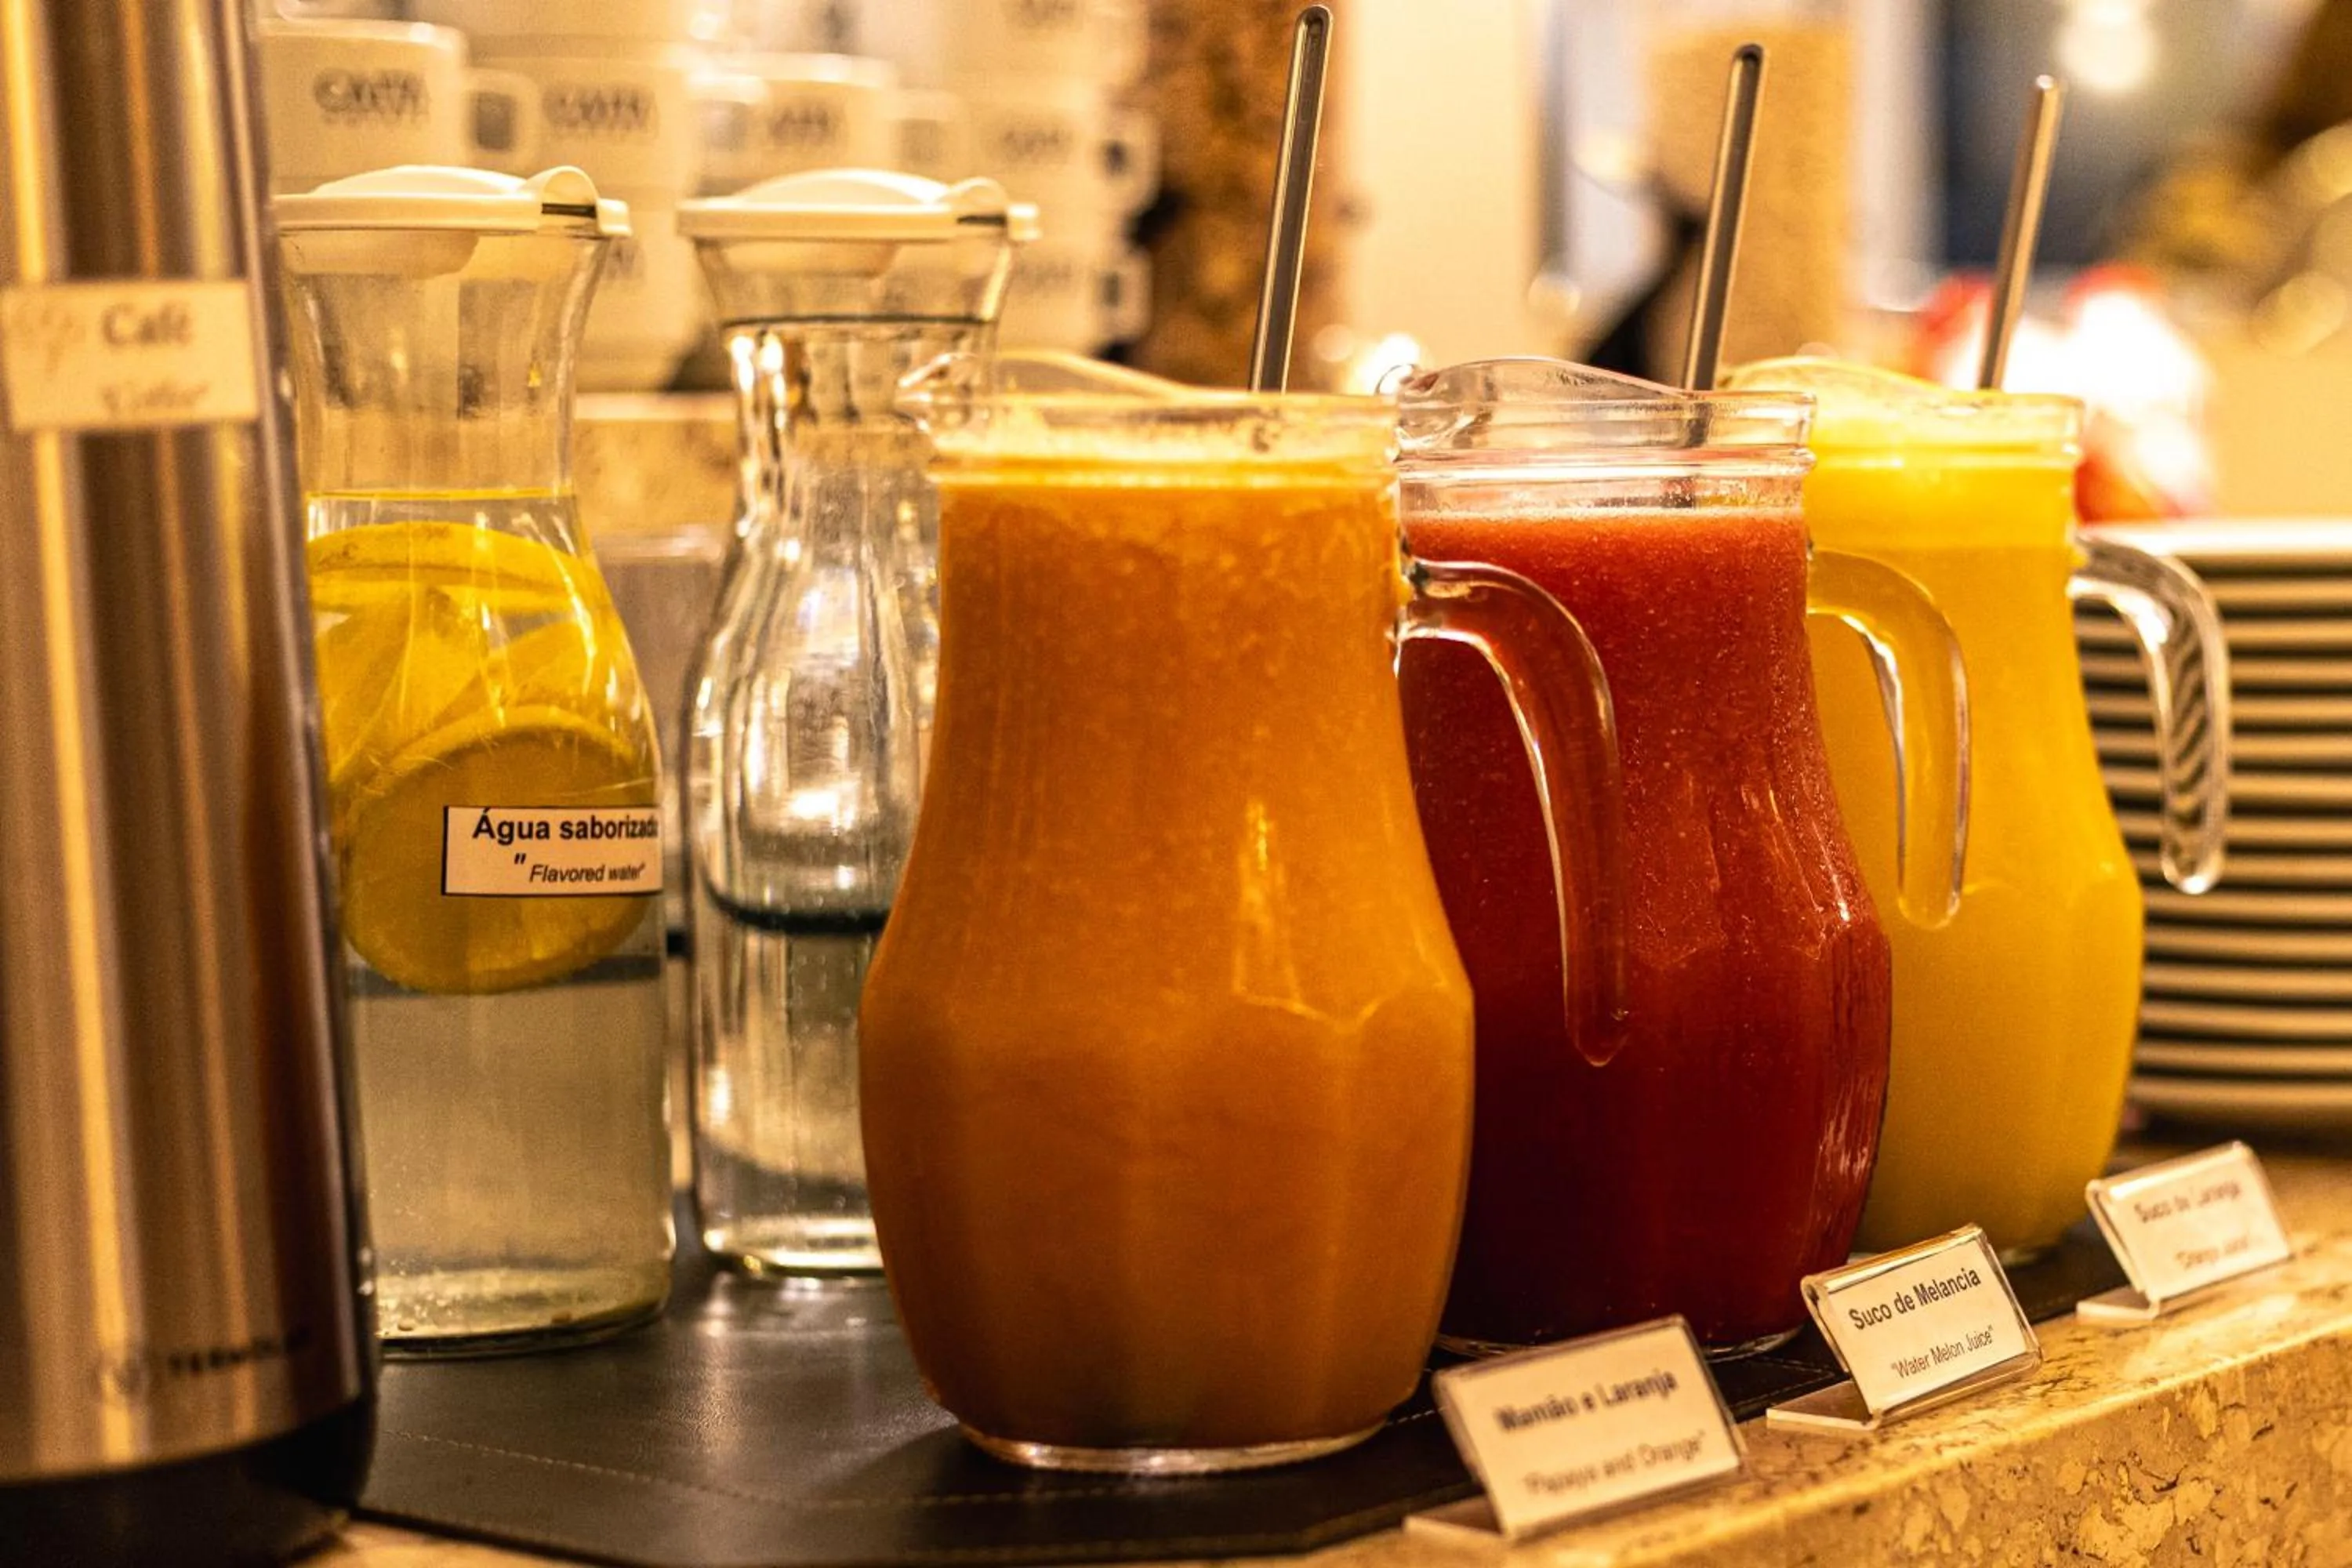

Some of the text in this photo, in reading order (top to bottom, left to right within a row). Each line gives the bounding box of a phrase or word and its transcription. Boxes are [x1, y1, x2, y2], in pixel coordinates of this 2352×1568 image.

[473, 808, 550, 845] Água
[1848, 1267, 1981, 1330] Suco de Melancia
[1891, 1324, 1994, 1379] "Water Melon Juice"
[1599, 1367, 1679, 1405] Laranja
